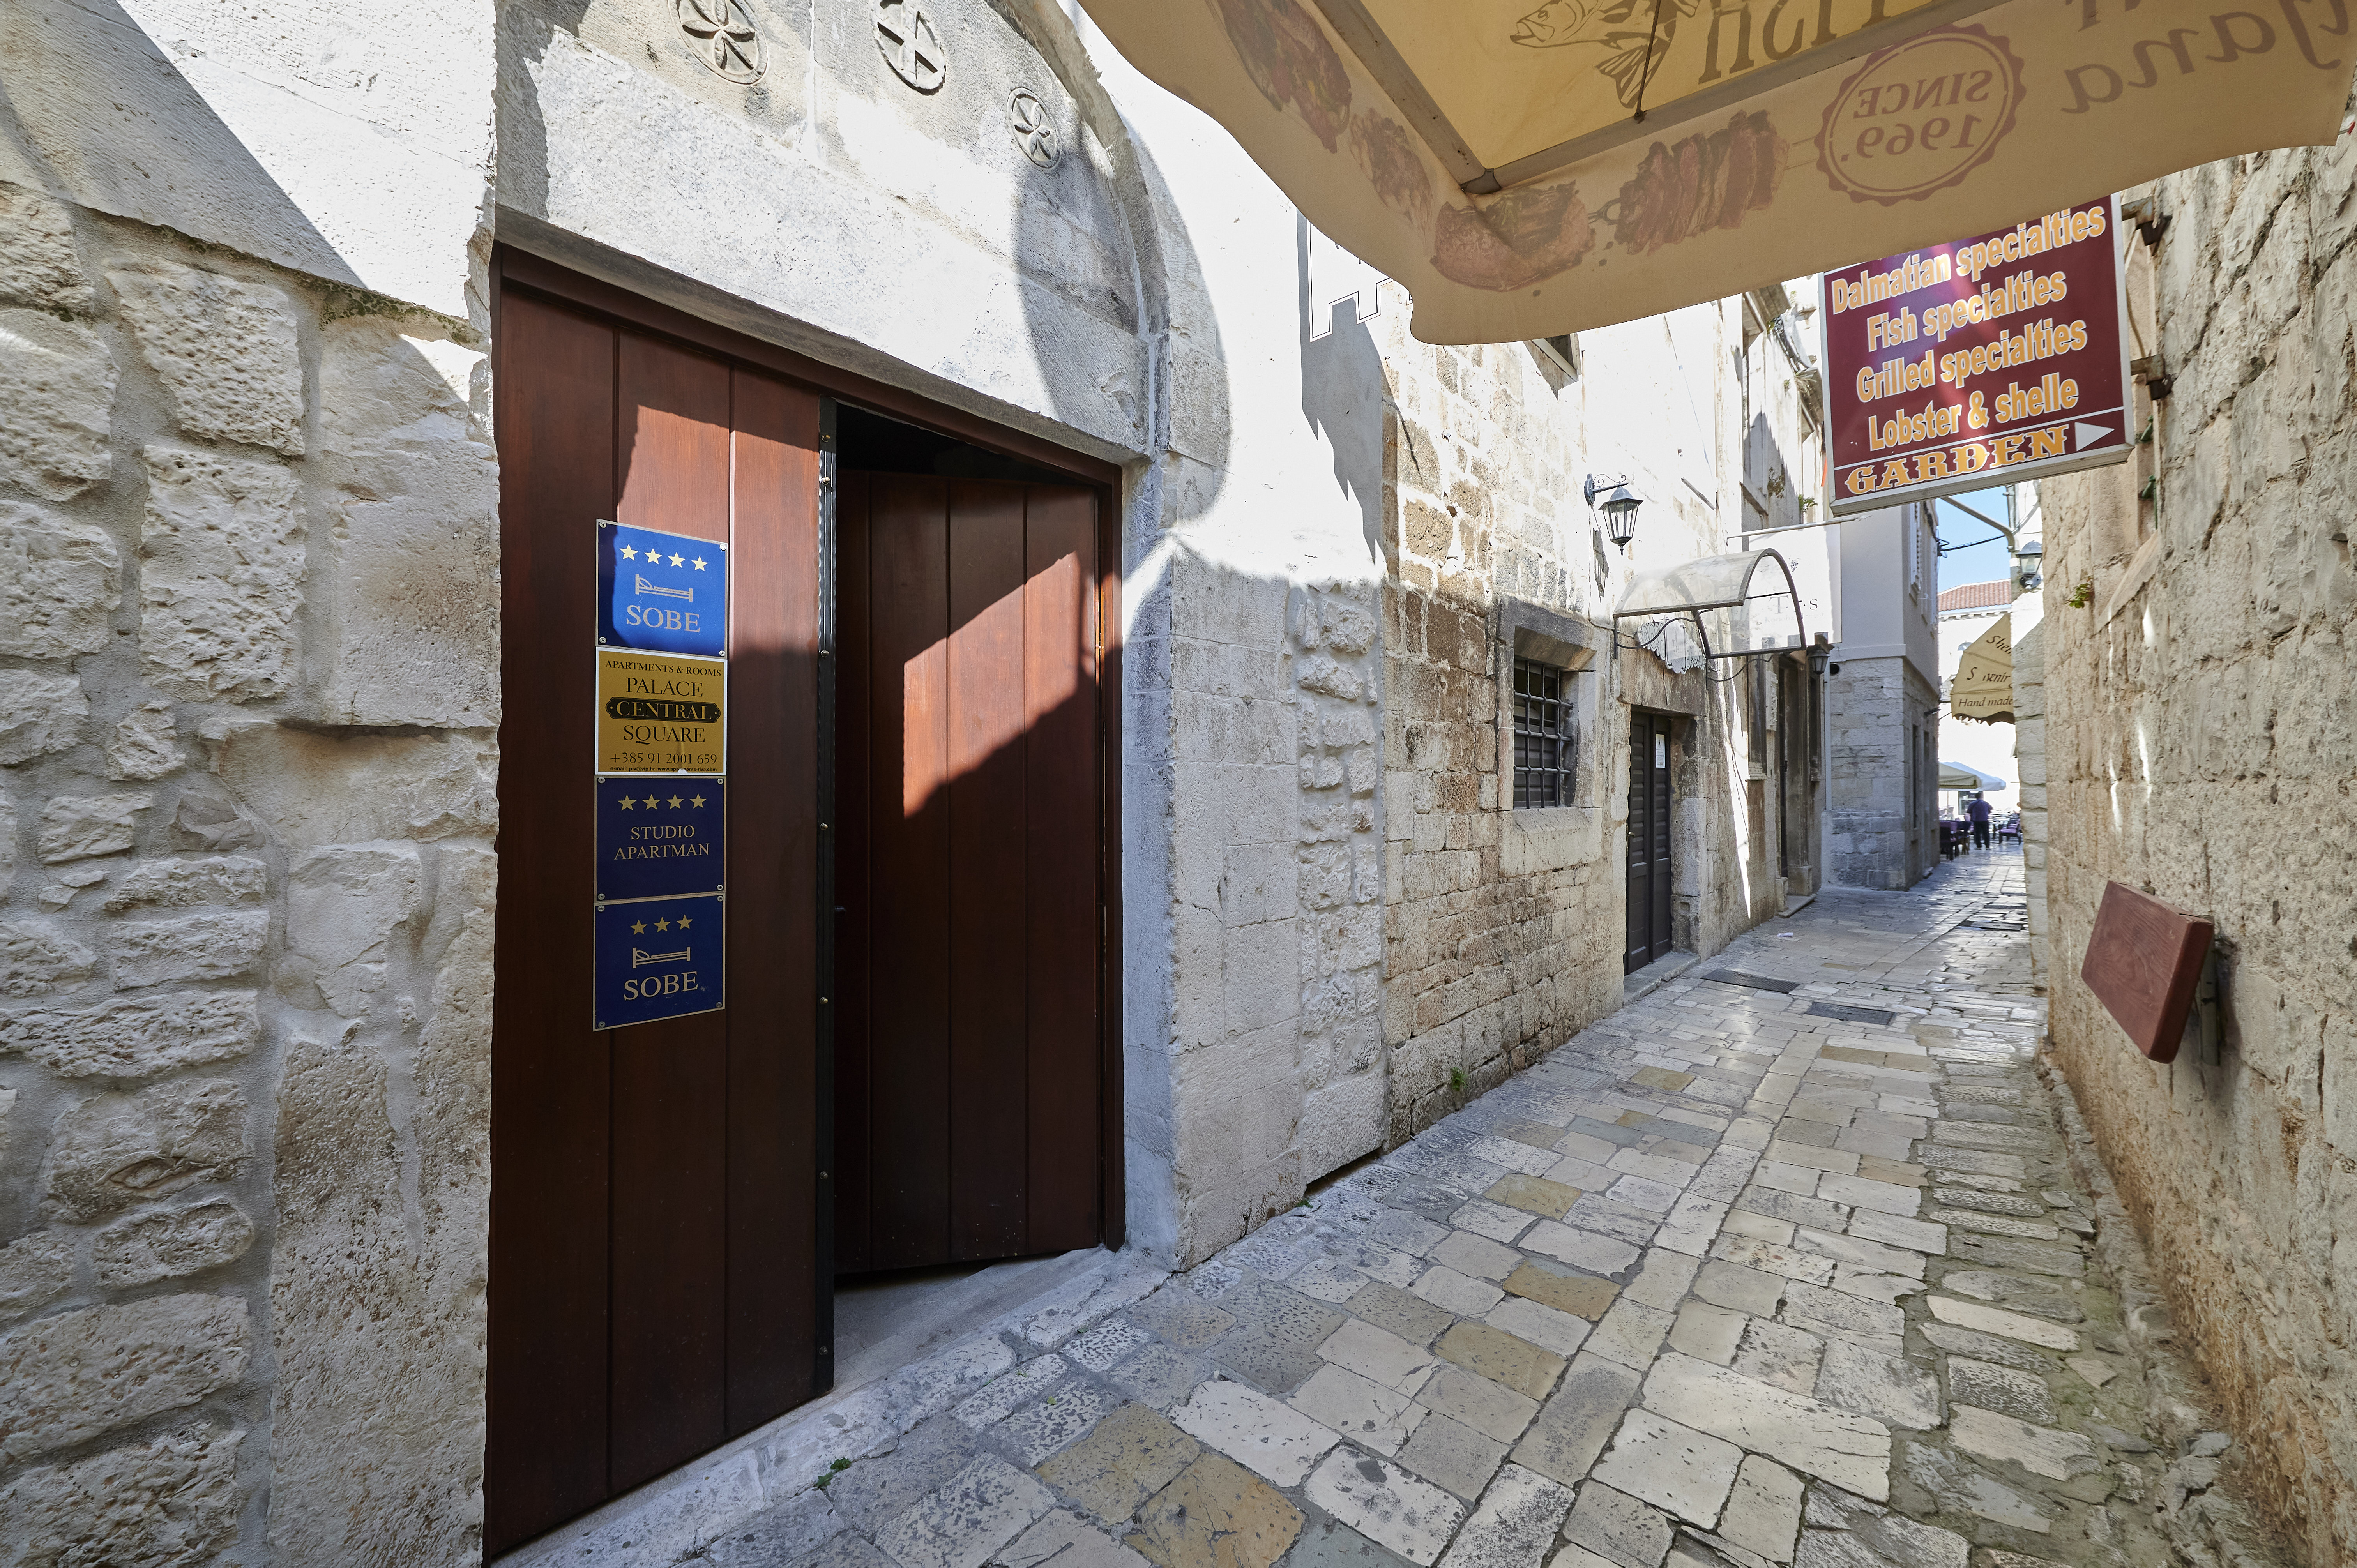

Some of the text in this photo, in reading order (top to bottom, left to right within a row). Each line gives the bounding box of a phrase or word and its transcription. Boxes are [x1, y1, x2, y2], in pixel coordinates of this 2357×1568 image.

[1831, 206, 2106, 315] Dalmatian specialties
[1867, 270, 2067, 353] Fish specialties
[1856, 319, 2088, 403] Grilled specialties
[1869, 372, 2079, 452] Lobster & shelle
[1845, 423, 2070, 495] GARDEN
[626, 604, 701, 633] SOBE
[605, 660, 673, 673] APARTMENTS
[686, 667, 721, 677] ROOMS
[626, 677, 703, 697] PALACE
[616, 701, 712, 720] CENTRAL
[1959, 696, 2013, 707] Hand made
[624, 725, 705, 745] SQUARE
[610, 752, 717, 764] +385 91 2001 659
[631, 825, 695, 841] STUDIO
[614, 843, 710, 860] APARTMAN
[623, 971, 699, 1001] SOBE
